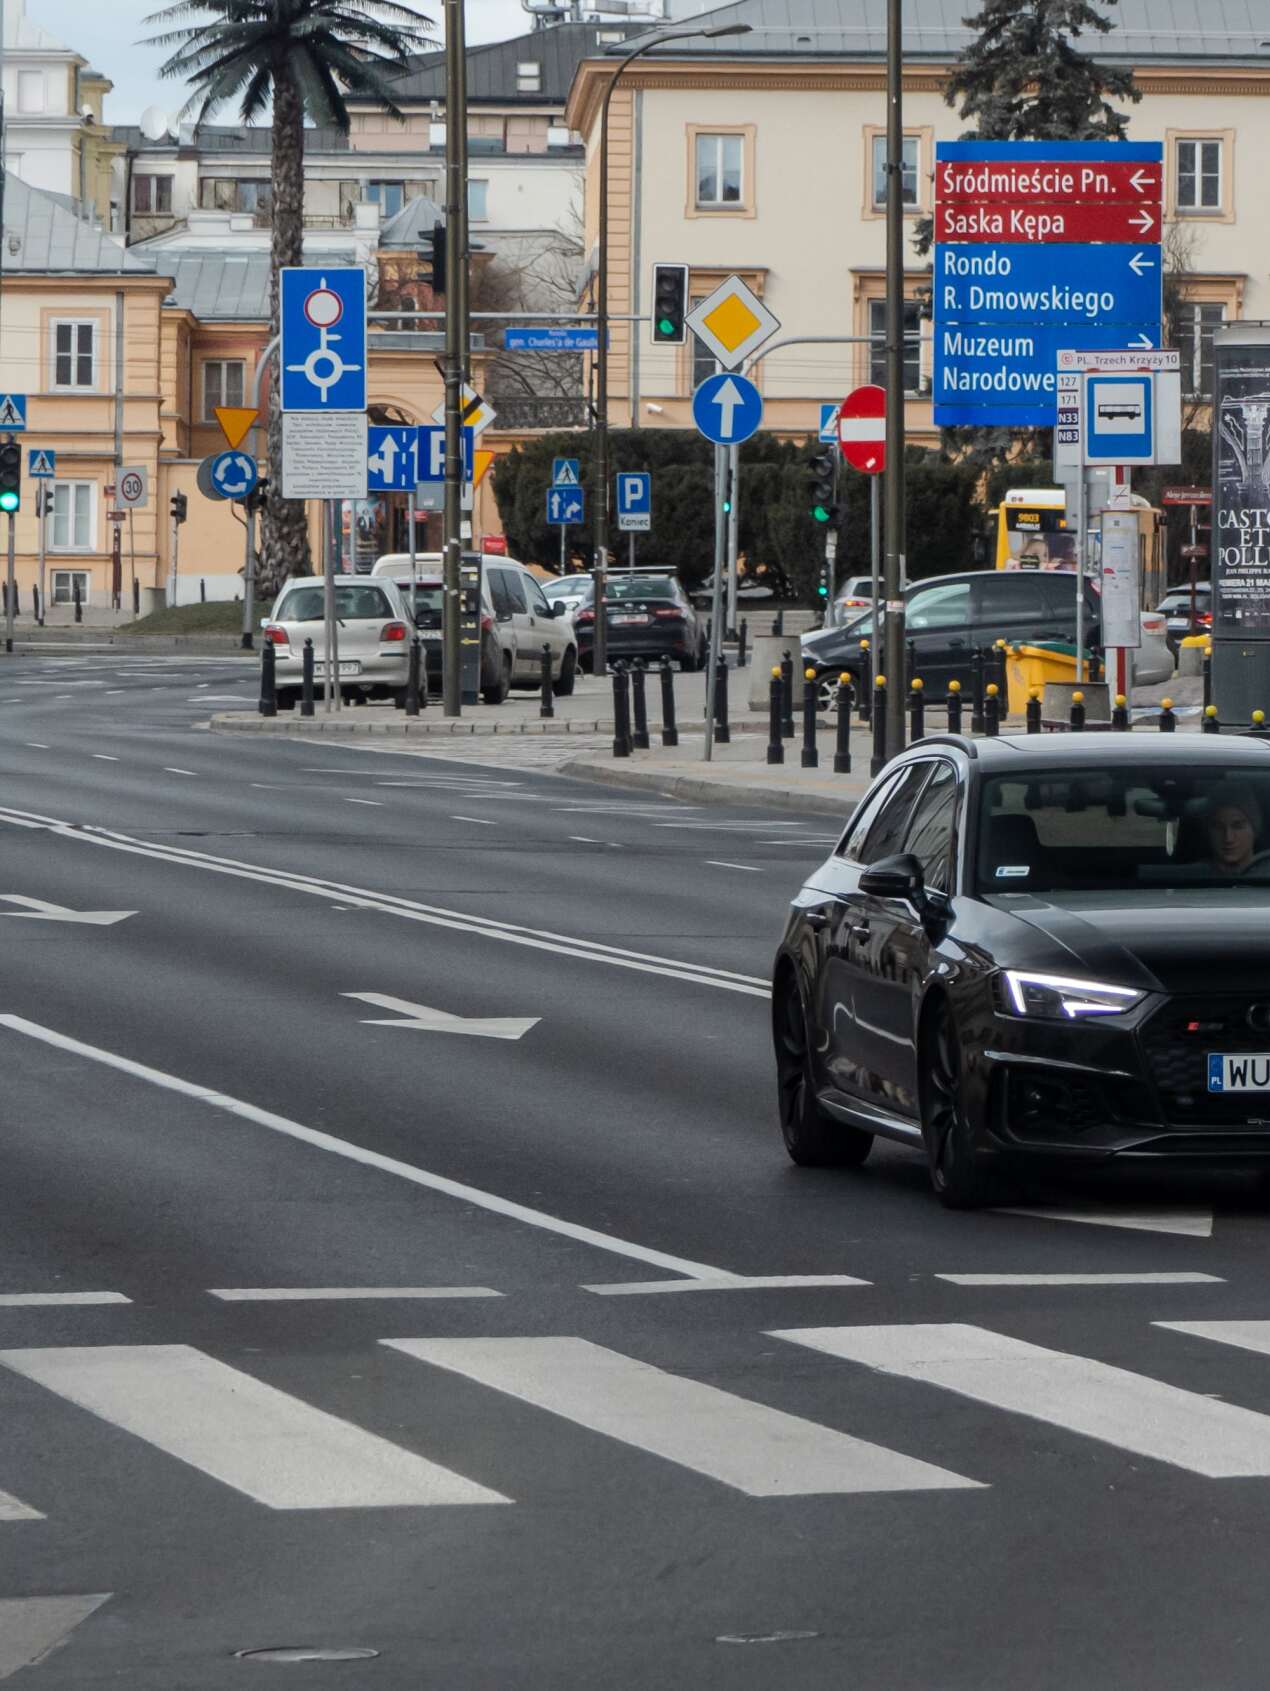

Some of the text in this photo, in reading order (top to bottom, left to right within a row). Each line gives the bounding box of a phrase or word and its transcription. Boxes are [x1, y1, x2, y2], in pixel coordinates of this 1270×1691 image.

[943, 162, 1117, 193] Śródmieście Pn.
[944, 207, 1065, 240] Saska Kępa
[943, 250, 1012, 276] Rondo
[943, 284, 1115, 317] R. Dmowskiego
[943, 331, 1034, 356] Muzeum
[1094, 356, 1127, 364] Trzech
[1165, 354, 1178, 364] 10
[943, 365, 1056, 392] Narodowe
[1060, 377, 1077, 386] 127
[1061, 395, 1077, 404] 171
[1059, 412, 1079, 423] N33
[1059, 430, 1079, 441] N83
[126, 480, 140, 494] 30
[620, 517, 649, 528] Koniec
[1239, 528, 1270, 547] ET
[1211, 1076, 1222, 1085] PL
[1229, 1059, 1270, 1087] WU
